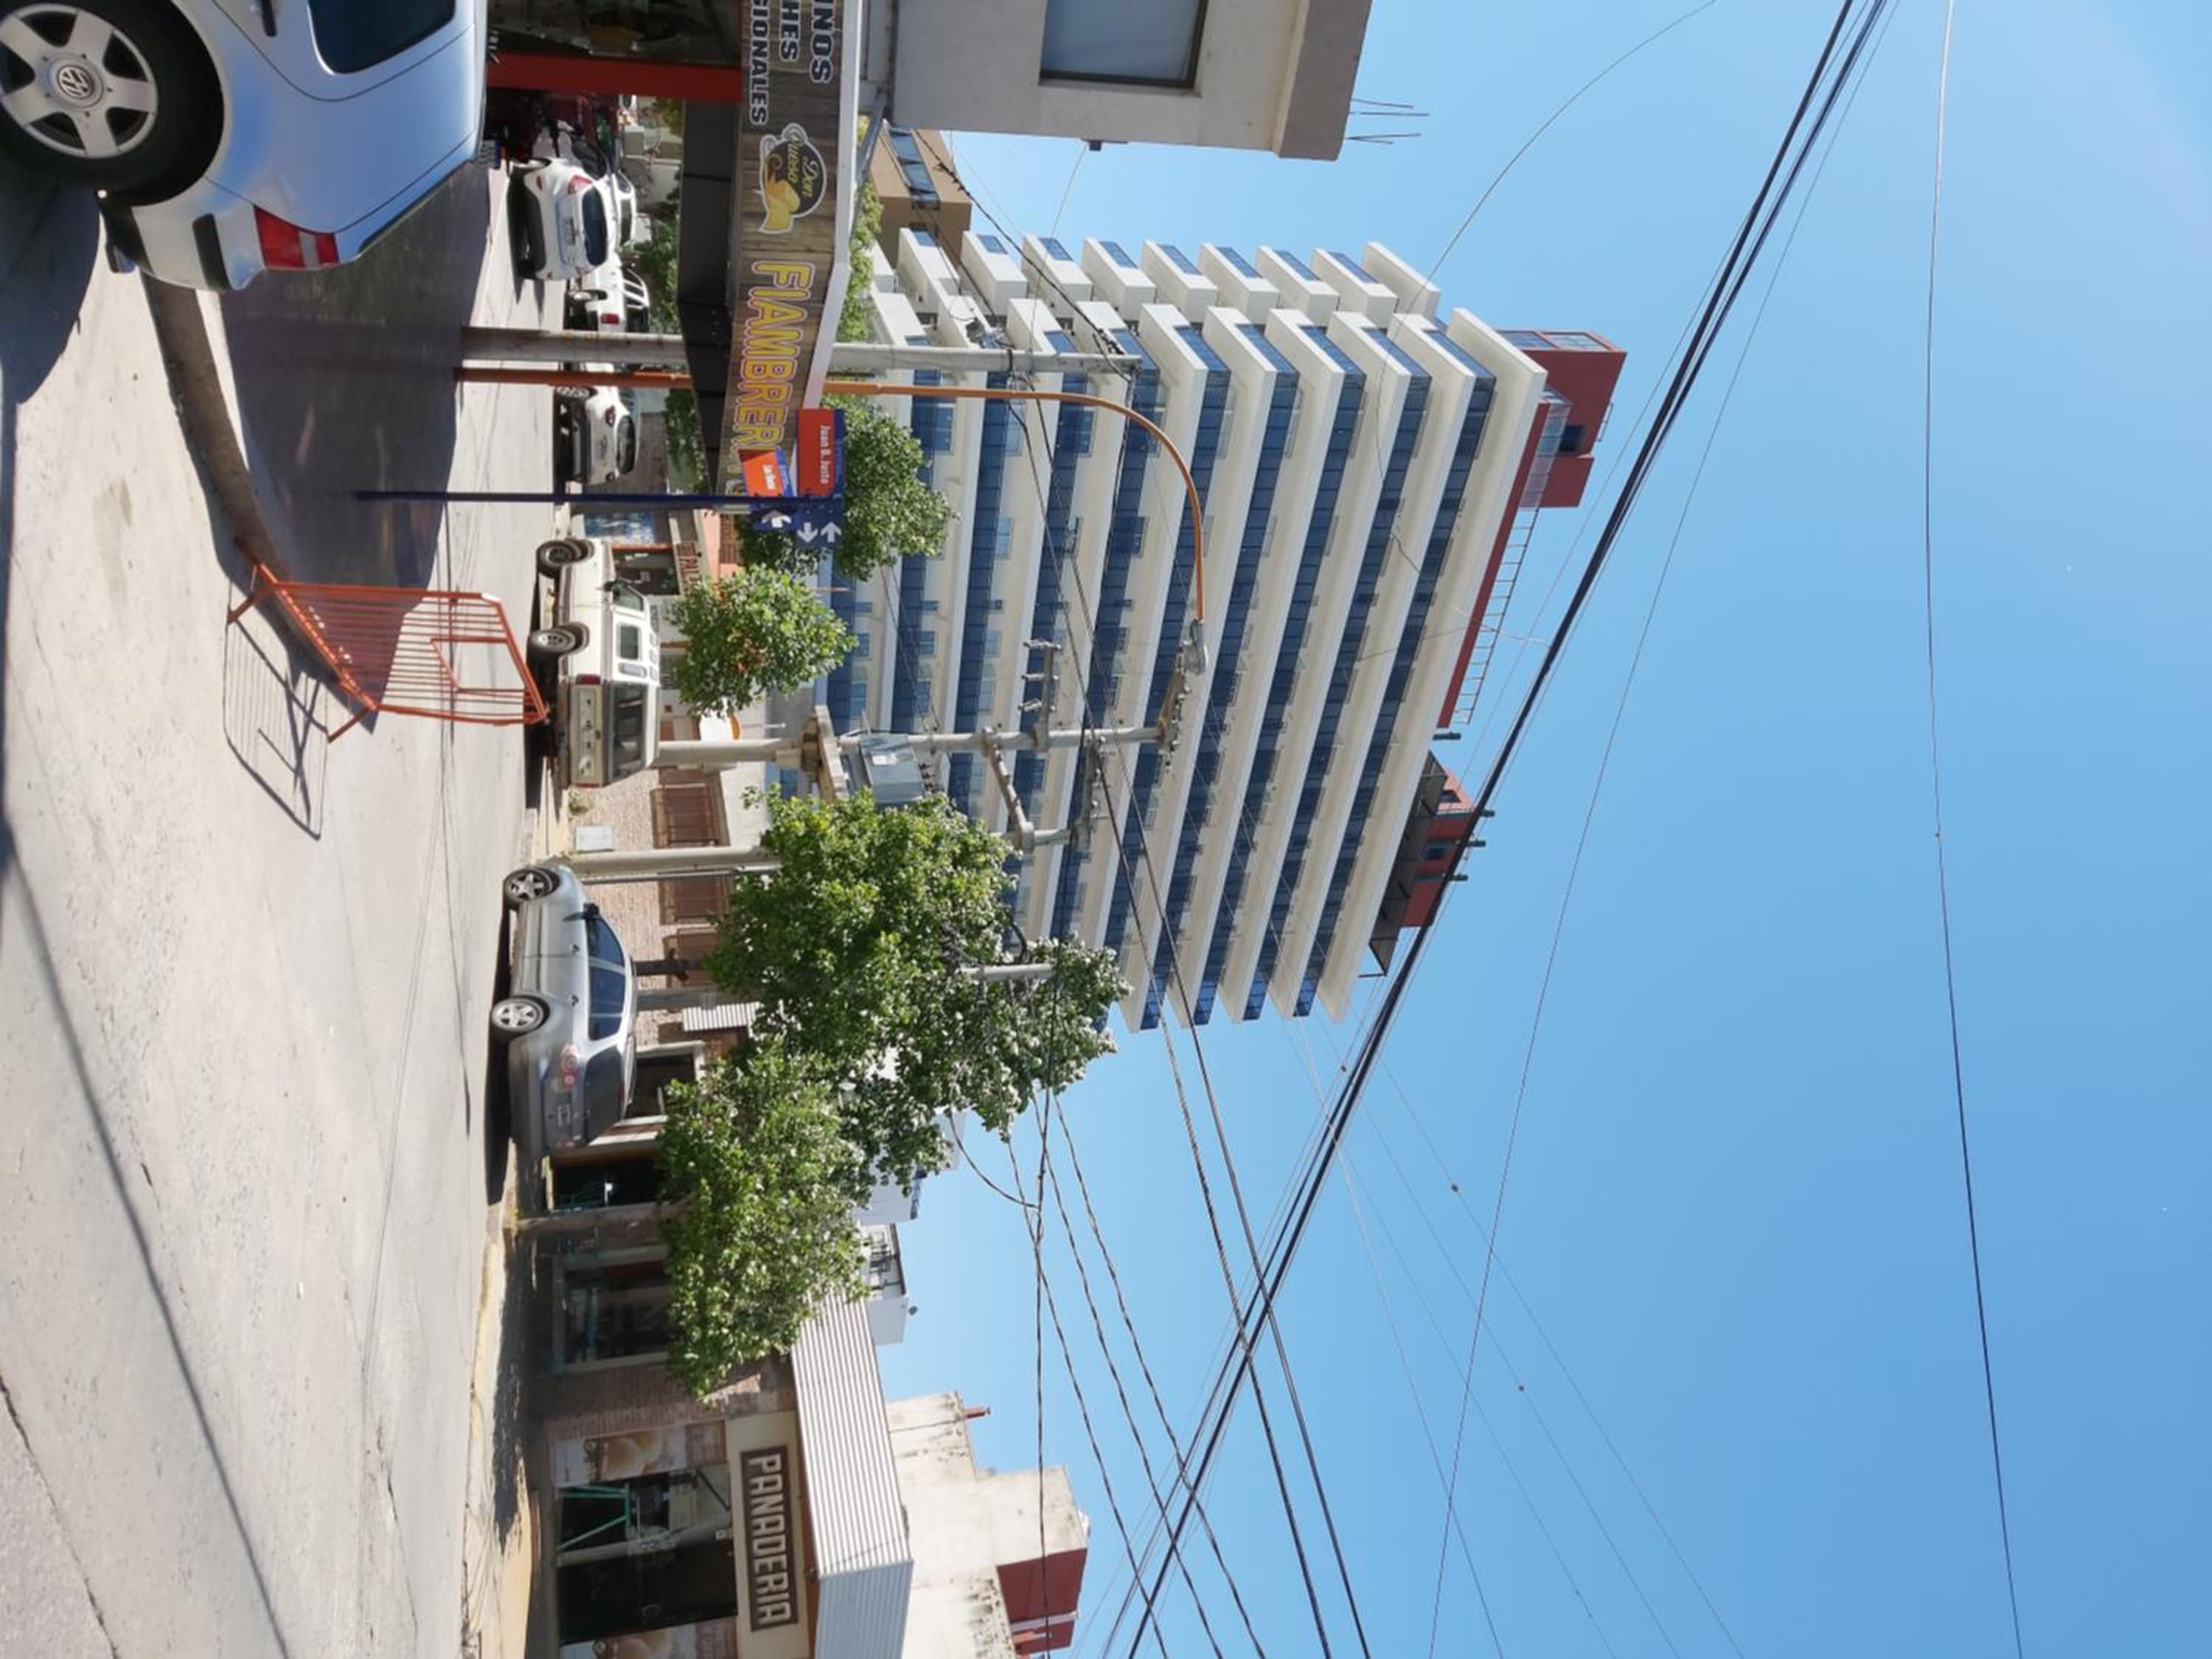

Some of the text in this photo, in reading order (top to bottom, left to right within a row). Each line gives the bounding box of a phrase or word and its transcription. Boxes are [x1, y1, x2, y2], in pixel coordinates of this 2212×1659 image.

[810, 0, 834, 83] NOS
[785, 125, 807, 184] Queso
[801, 157, 820, 198] Don
[727, 261, 815, 473] FIAMBRERI
[819, 425, 832, 448] Juan
[819, 460, 832, 485] Justo
[748, 1453, 792, 1623] PANADERIA
